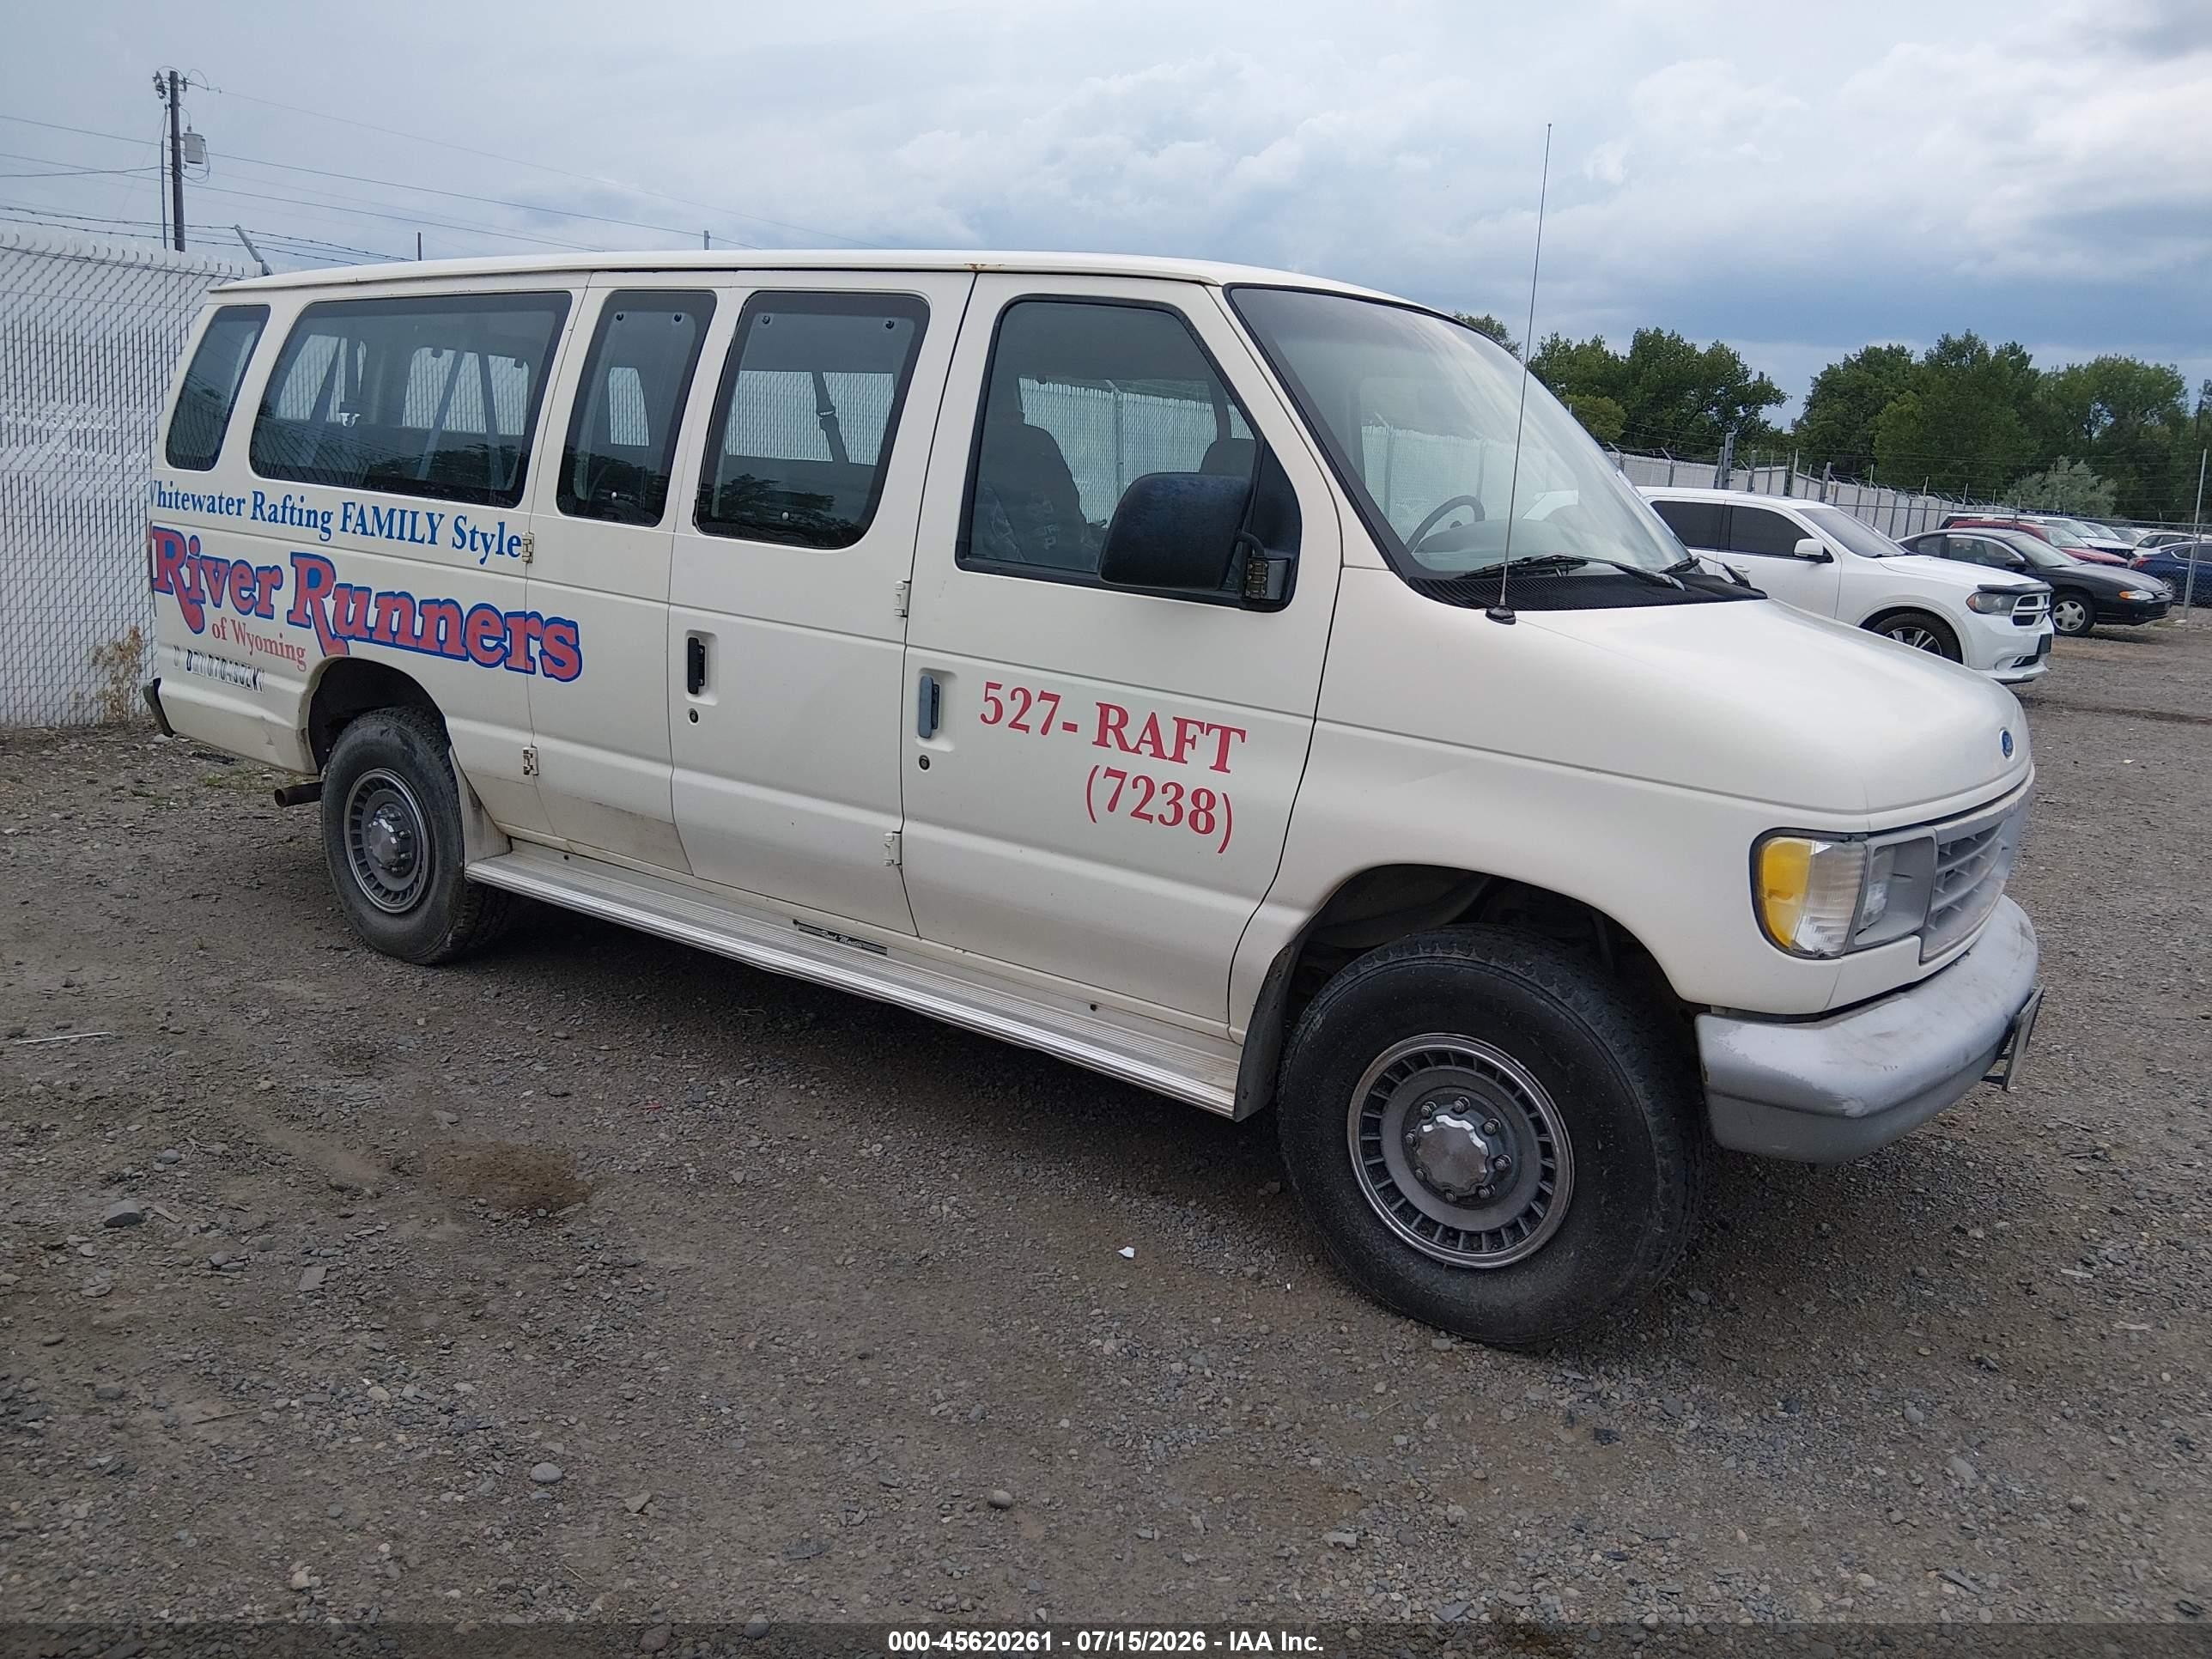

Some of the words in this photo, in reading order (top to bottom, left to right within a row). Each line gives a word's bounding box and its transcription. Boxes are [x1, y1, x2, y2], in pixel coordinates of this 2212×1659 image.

[250, 490, 334, 542] Rafting
[339, 501, 445, 546] FAMILY
[452, 515, 522, 564] Style
[151, 526, 283, 635] River
[288, 551, 583, 684] Runners
[211, 617, 228, 641] of
[230, 619, 307, 673] Wyoming
[980, 682, 1079, 736] 527-
[1091, 701, 1247, 774] RAFT
[1086, 764, 1233, 854] (7238)
